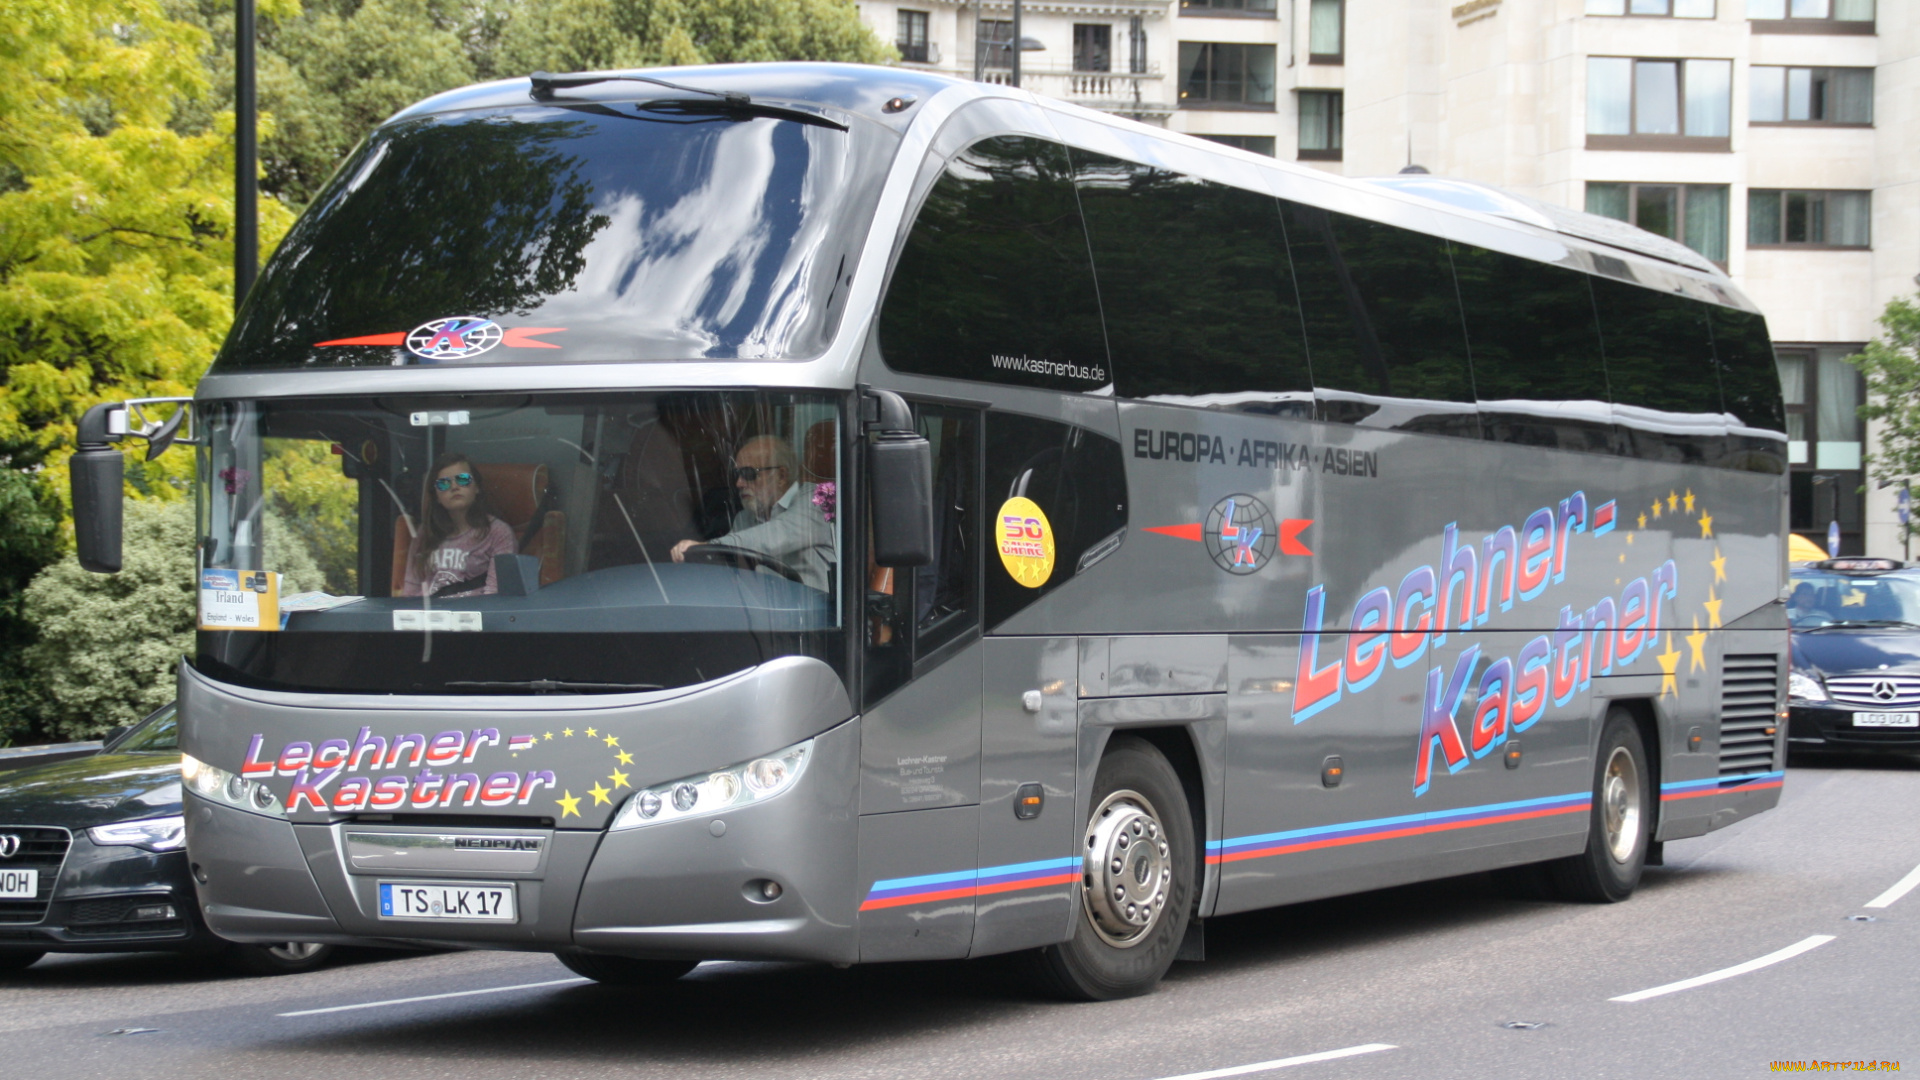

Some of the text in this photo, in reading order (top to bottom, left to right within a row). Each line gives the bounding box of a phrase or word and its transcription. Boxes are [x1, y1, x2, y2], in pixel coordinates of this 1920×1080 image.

[991, 354, 1105, 381] www.kastnerbus.de
[1134, 428, 1377, 478] EUROPA AFRIKA ASIEN
[1003, 516, 1043, 540] 50
[215, 591, 244, 604] Irland
[234, 614, 255, 623] Wales
[1412, 558, 1679, 798] Kastner
[286, 769, 556, 813] Kastner
[455, 838, 538, 850] NEOPLAN
[401, 889, 429, 913] TS
[443, 890, 471, 914] LK
[477, 891, 503, 915] 17
